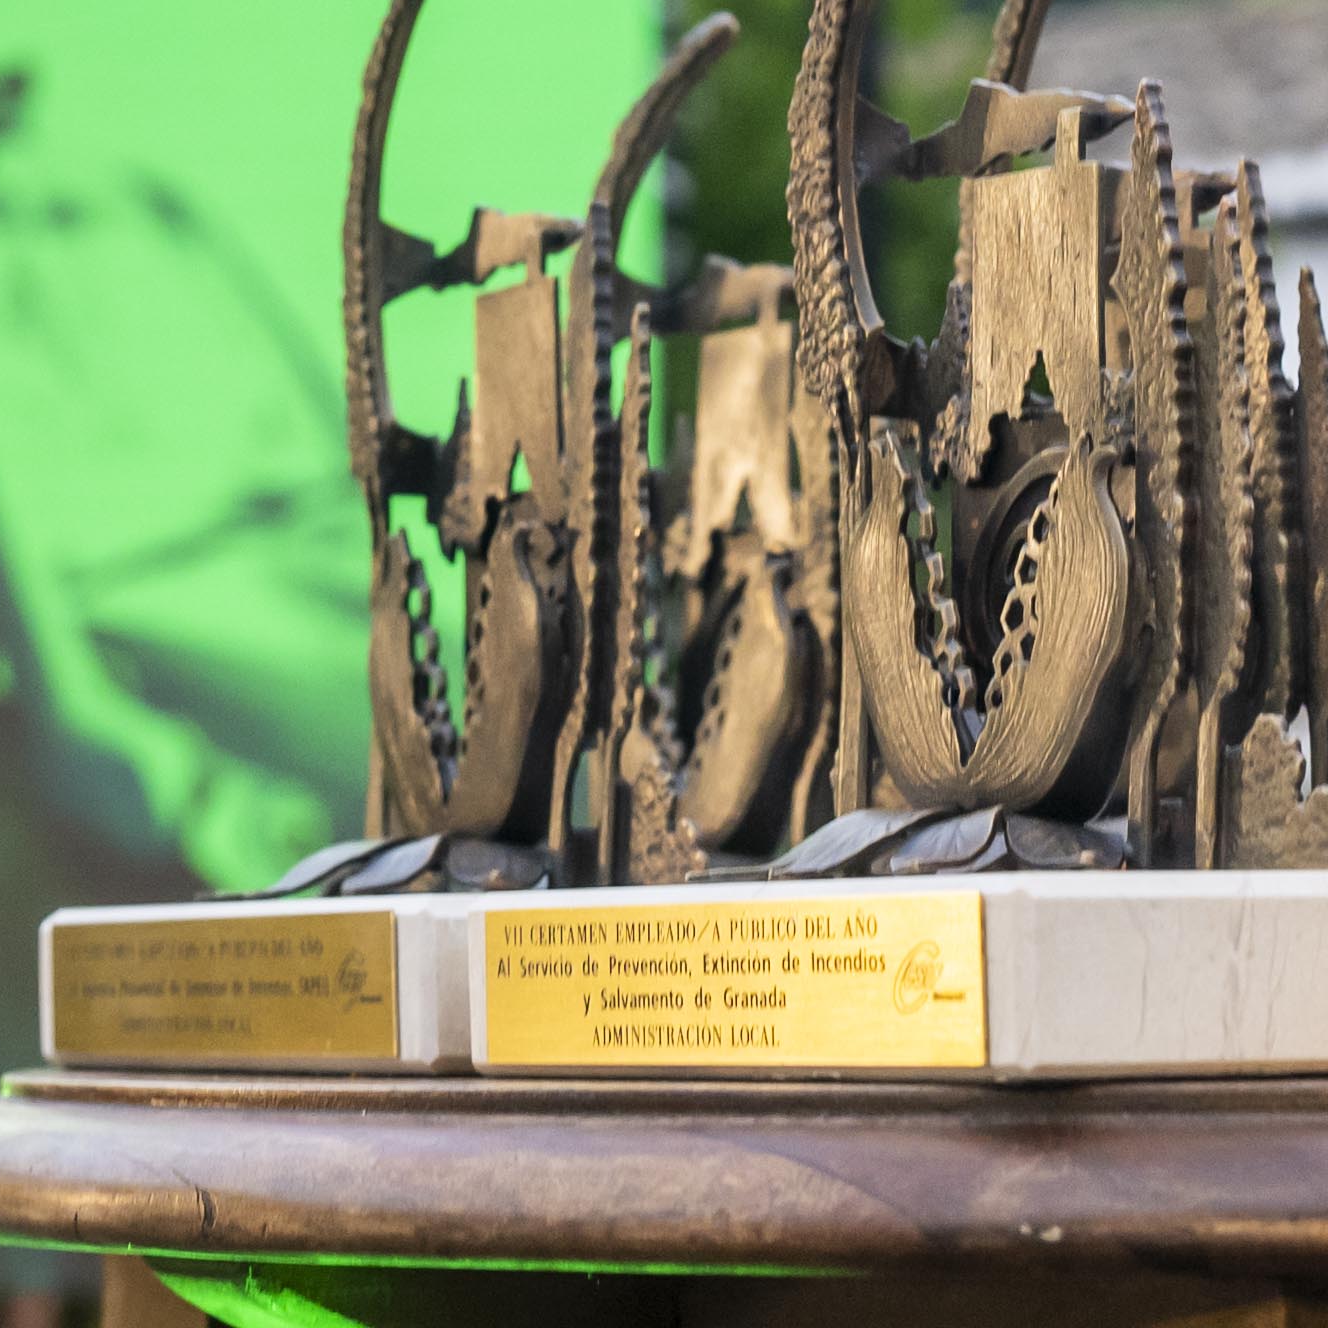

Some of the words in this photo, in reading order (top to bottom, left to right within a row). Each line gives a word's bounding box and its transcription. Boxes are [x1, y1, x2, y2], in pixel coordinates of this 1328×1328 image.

[504, 924, 523, 947] VII
[530, 922, 608, 947] CERTAMEN
[616, 918, 721, 945] EMPLEADO/A
[730, 910, 796, 943] PÚBLICO
[805, 916, 835, 941] DEL
[843, 908, 878, 939] AÑO
[497, 956, 511, 978] Al
[520, 954, 573, 979] Servicio
[582, 953, 599, 976] de
[609, 952, 692, 979] Prevención,
[703, 949, 771, 976] Extinción
[782, 948, 800, 974] de
[812, 946, 886, 973] Incendios
[583, 992, 592, 1016] y
[601, 986, 684, 1011] Salvamento
[695, 986, 712, 1009] de
[724, 984, 787, 1009] Granada
[593, 1017, 722, 1048] ADMINISTRACIÓN
[731, 1023, 780, 1048] LOCAL
